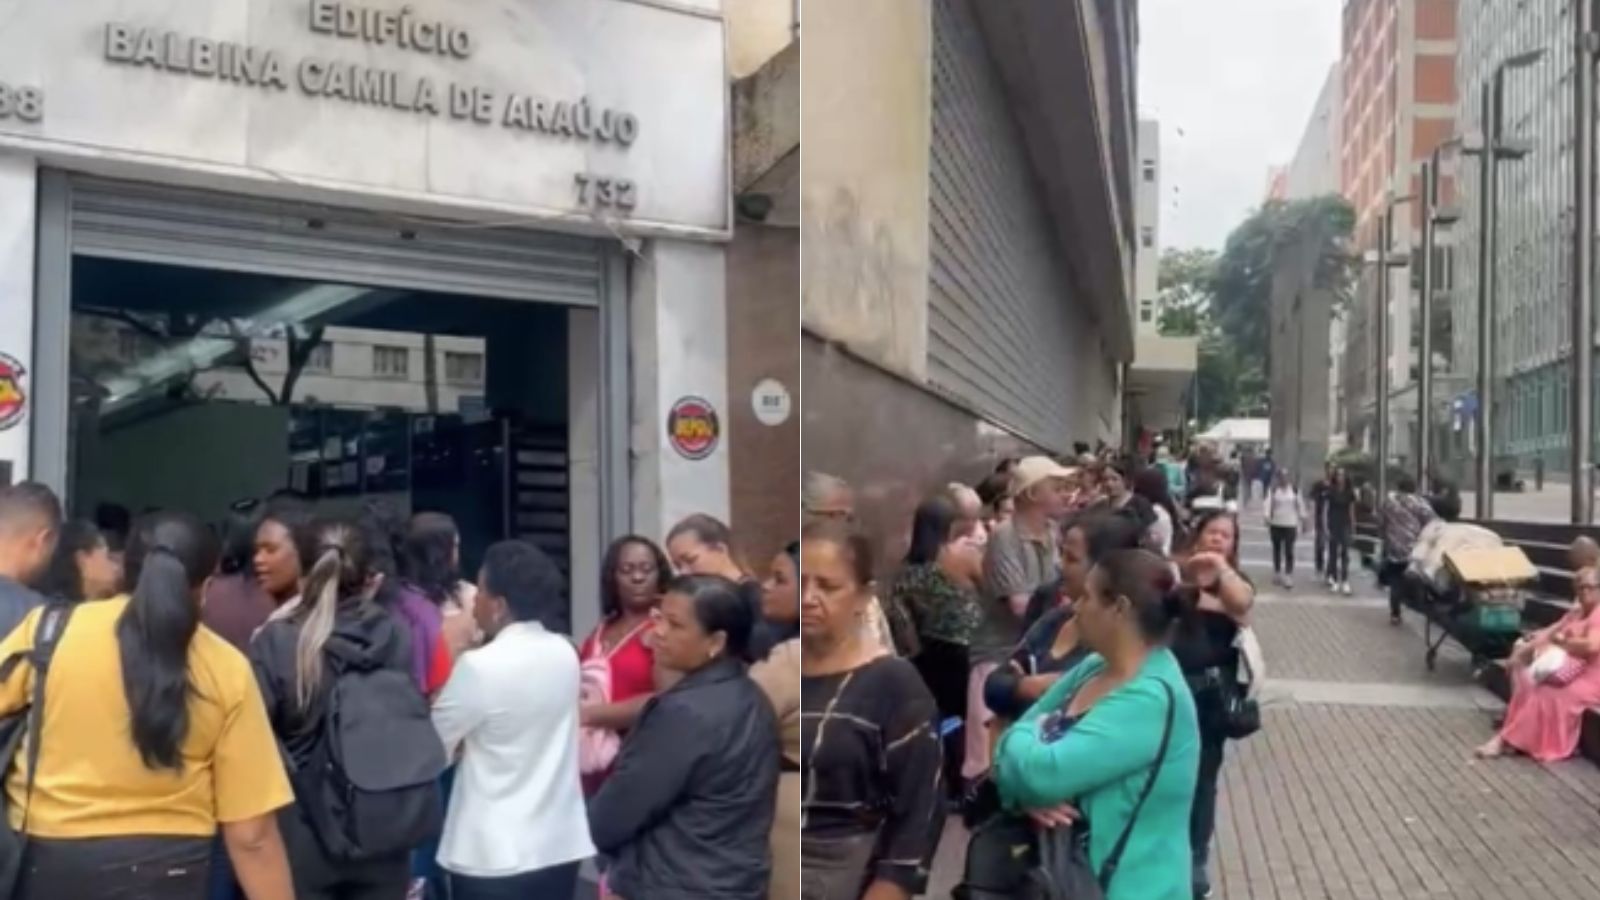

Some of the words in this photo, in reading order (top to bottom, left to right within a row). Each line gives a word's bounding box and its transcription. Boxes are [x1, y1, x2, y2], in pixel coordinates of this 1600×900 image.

[308, 0, 474, 60] EDIFÍCIO
[105, 22, 287, 90] BALBINA
[297, 57, 440, 116] CAMILA
[450, 83, 493, 125] DE
[502, 94, 639, 147] ARAÚJO
[573, 172, 637, 211] 732
